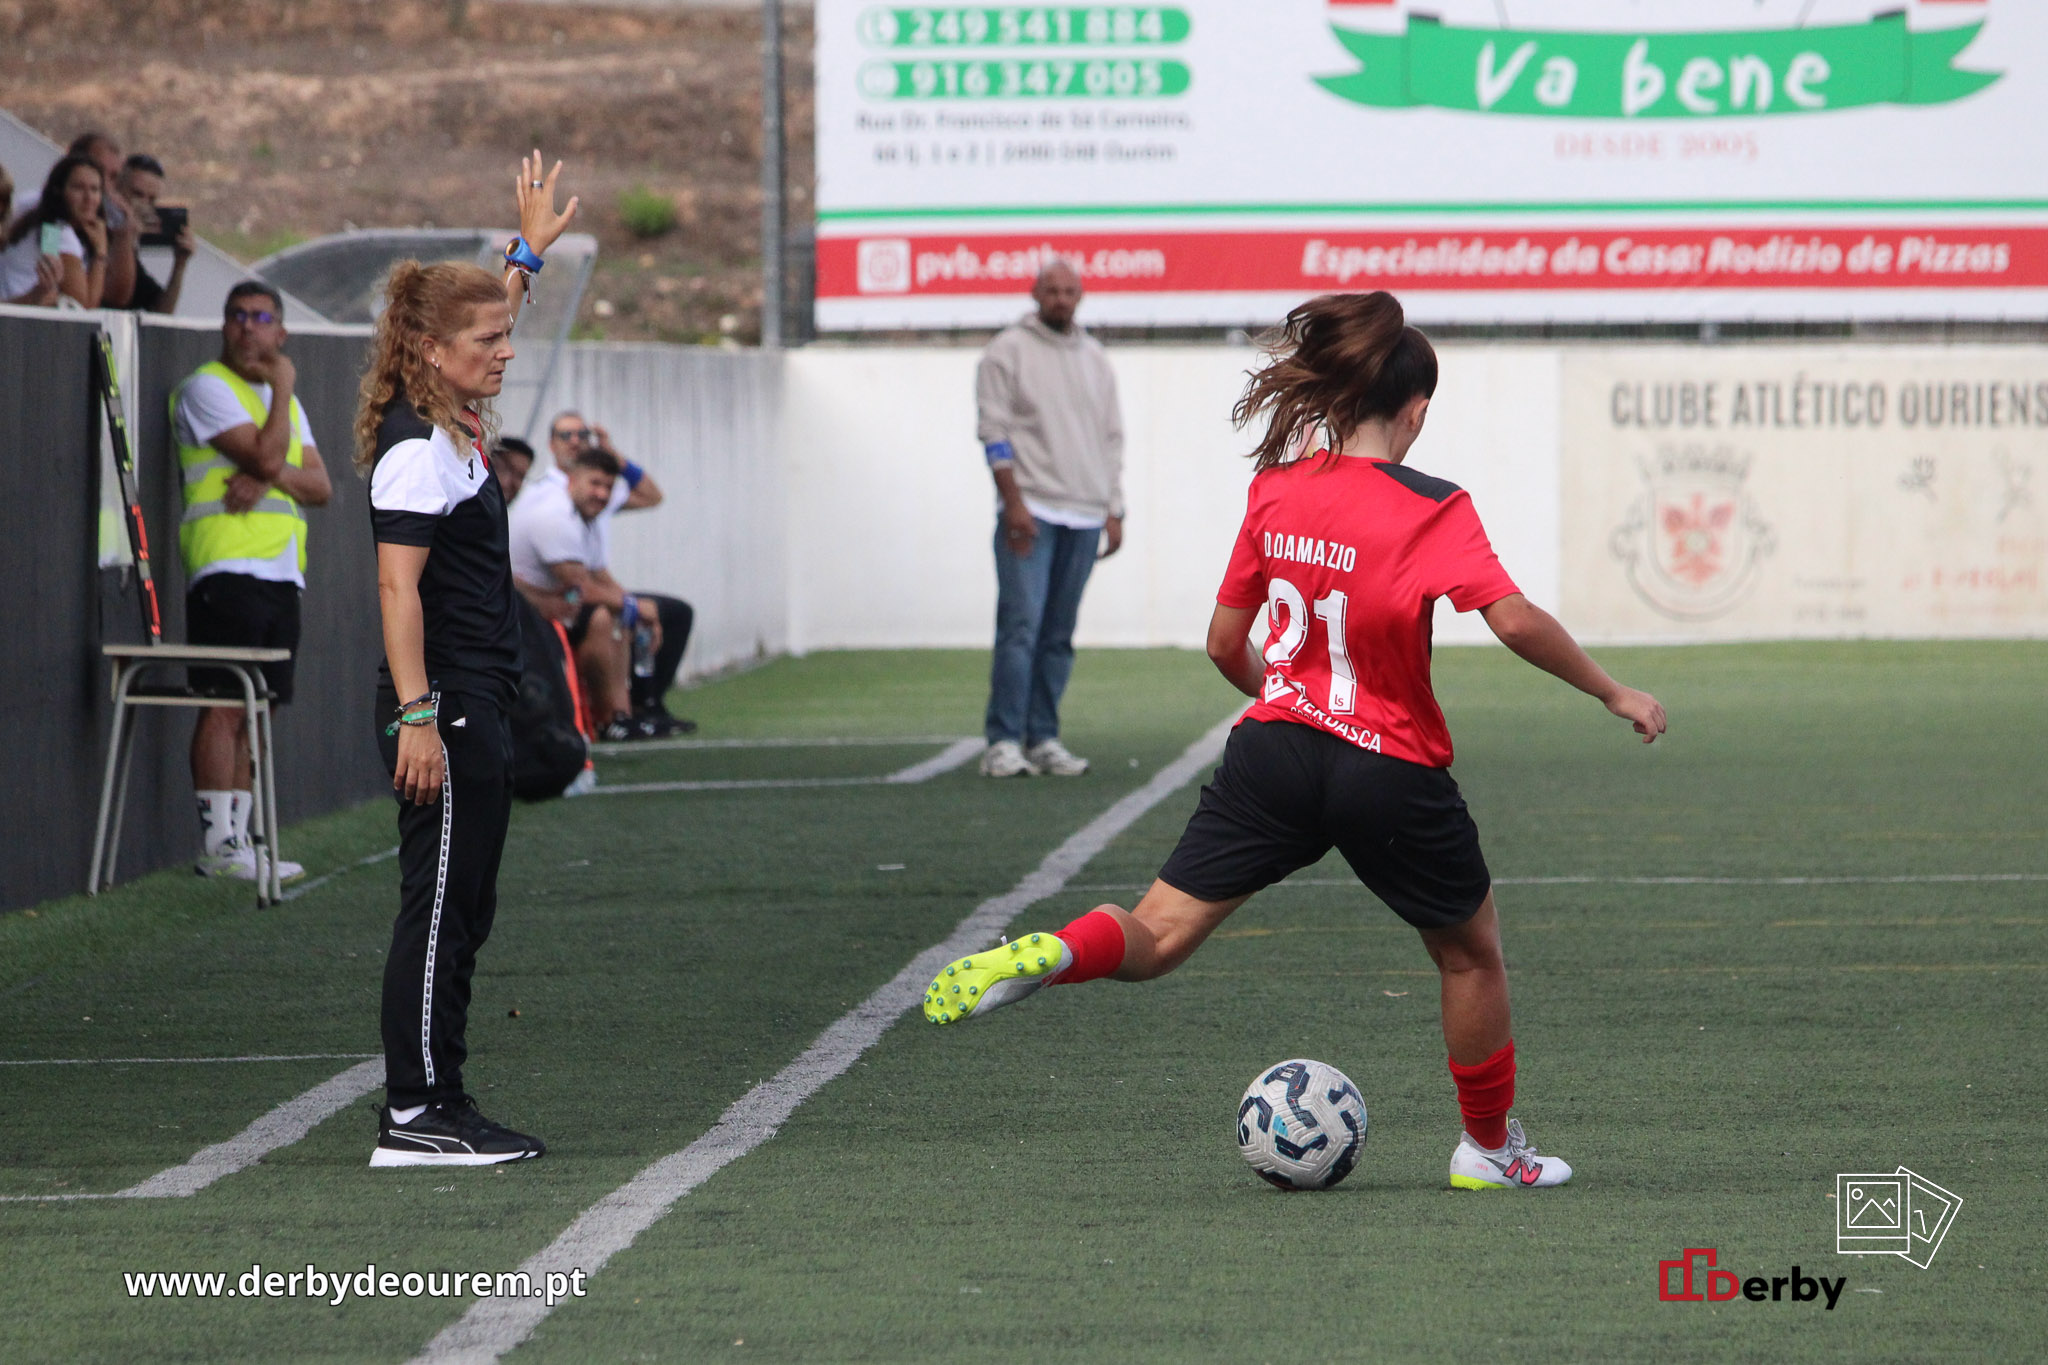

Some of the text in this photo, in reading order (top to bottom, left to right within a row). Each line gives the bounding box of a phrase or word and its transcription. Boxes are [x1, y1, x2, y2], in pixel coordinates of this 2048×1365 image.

[910, 8, 1164, 42] 249 541 884
[910, 60, 1164, 96] 916 347 005
[1475, 38, 1832, 117] Va bene
[1553, 132, 1663, 158] DESDE
[1301, 238, 1547, 281] Especialidade
[1551, 240, 1599, 273] da
[1604, 238, 1703, 273] Casa:
[1846, 237, 1892, 272] de
[1897, 236, 2010, 273] Pizzas
[1611, 383, 1715, 427] CLUBE
[1732, 374, 1886, 427] ATLÉTICO
[1264, 578, 1357, 715] 21
